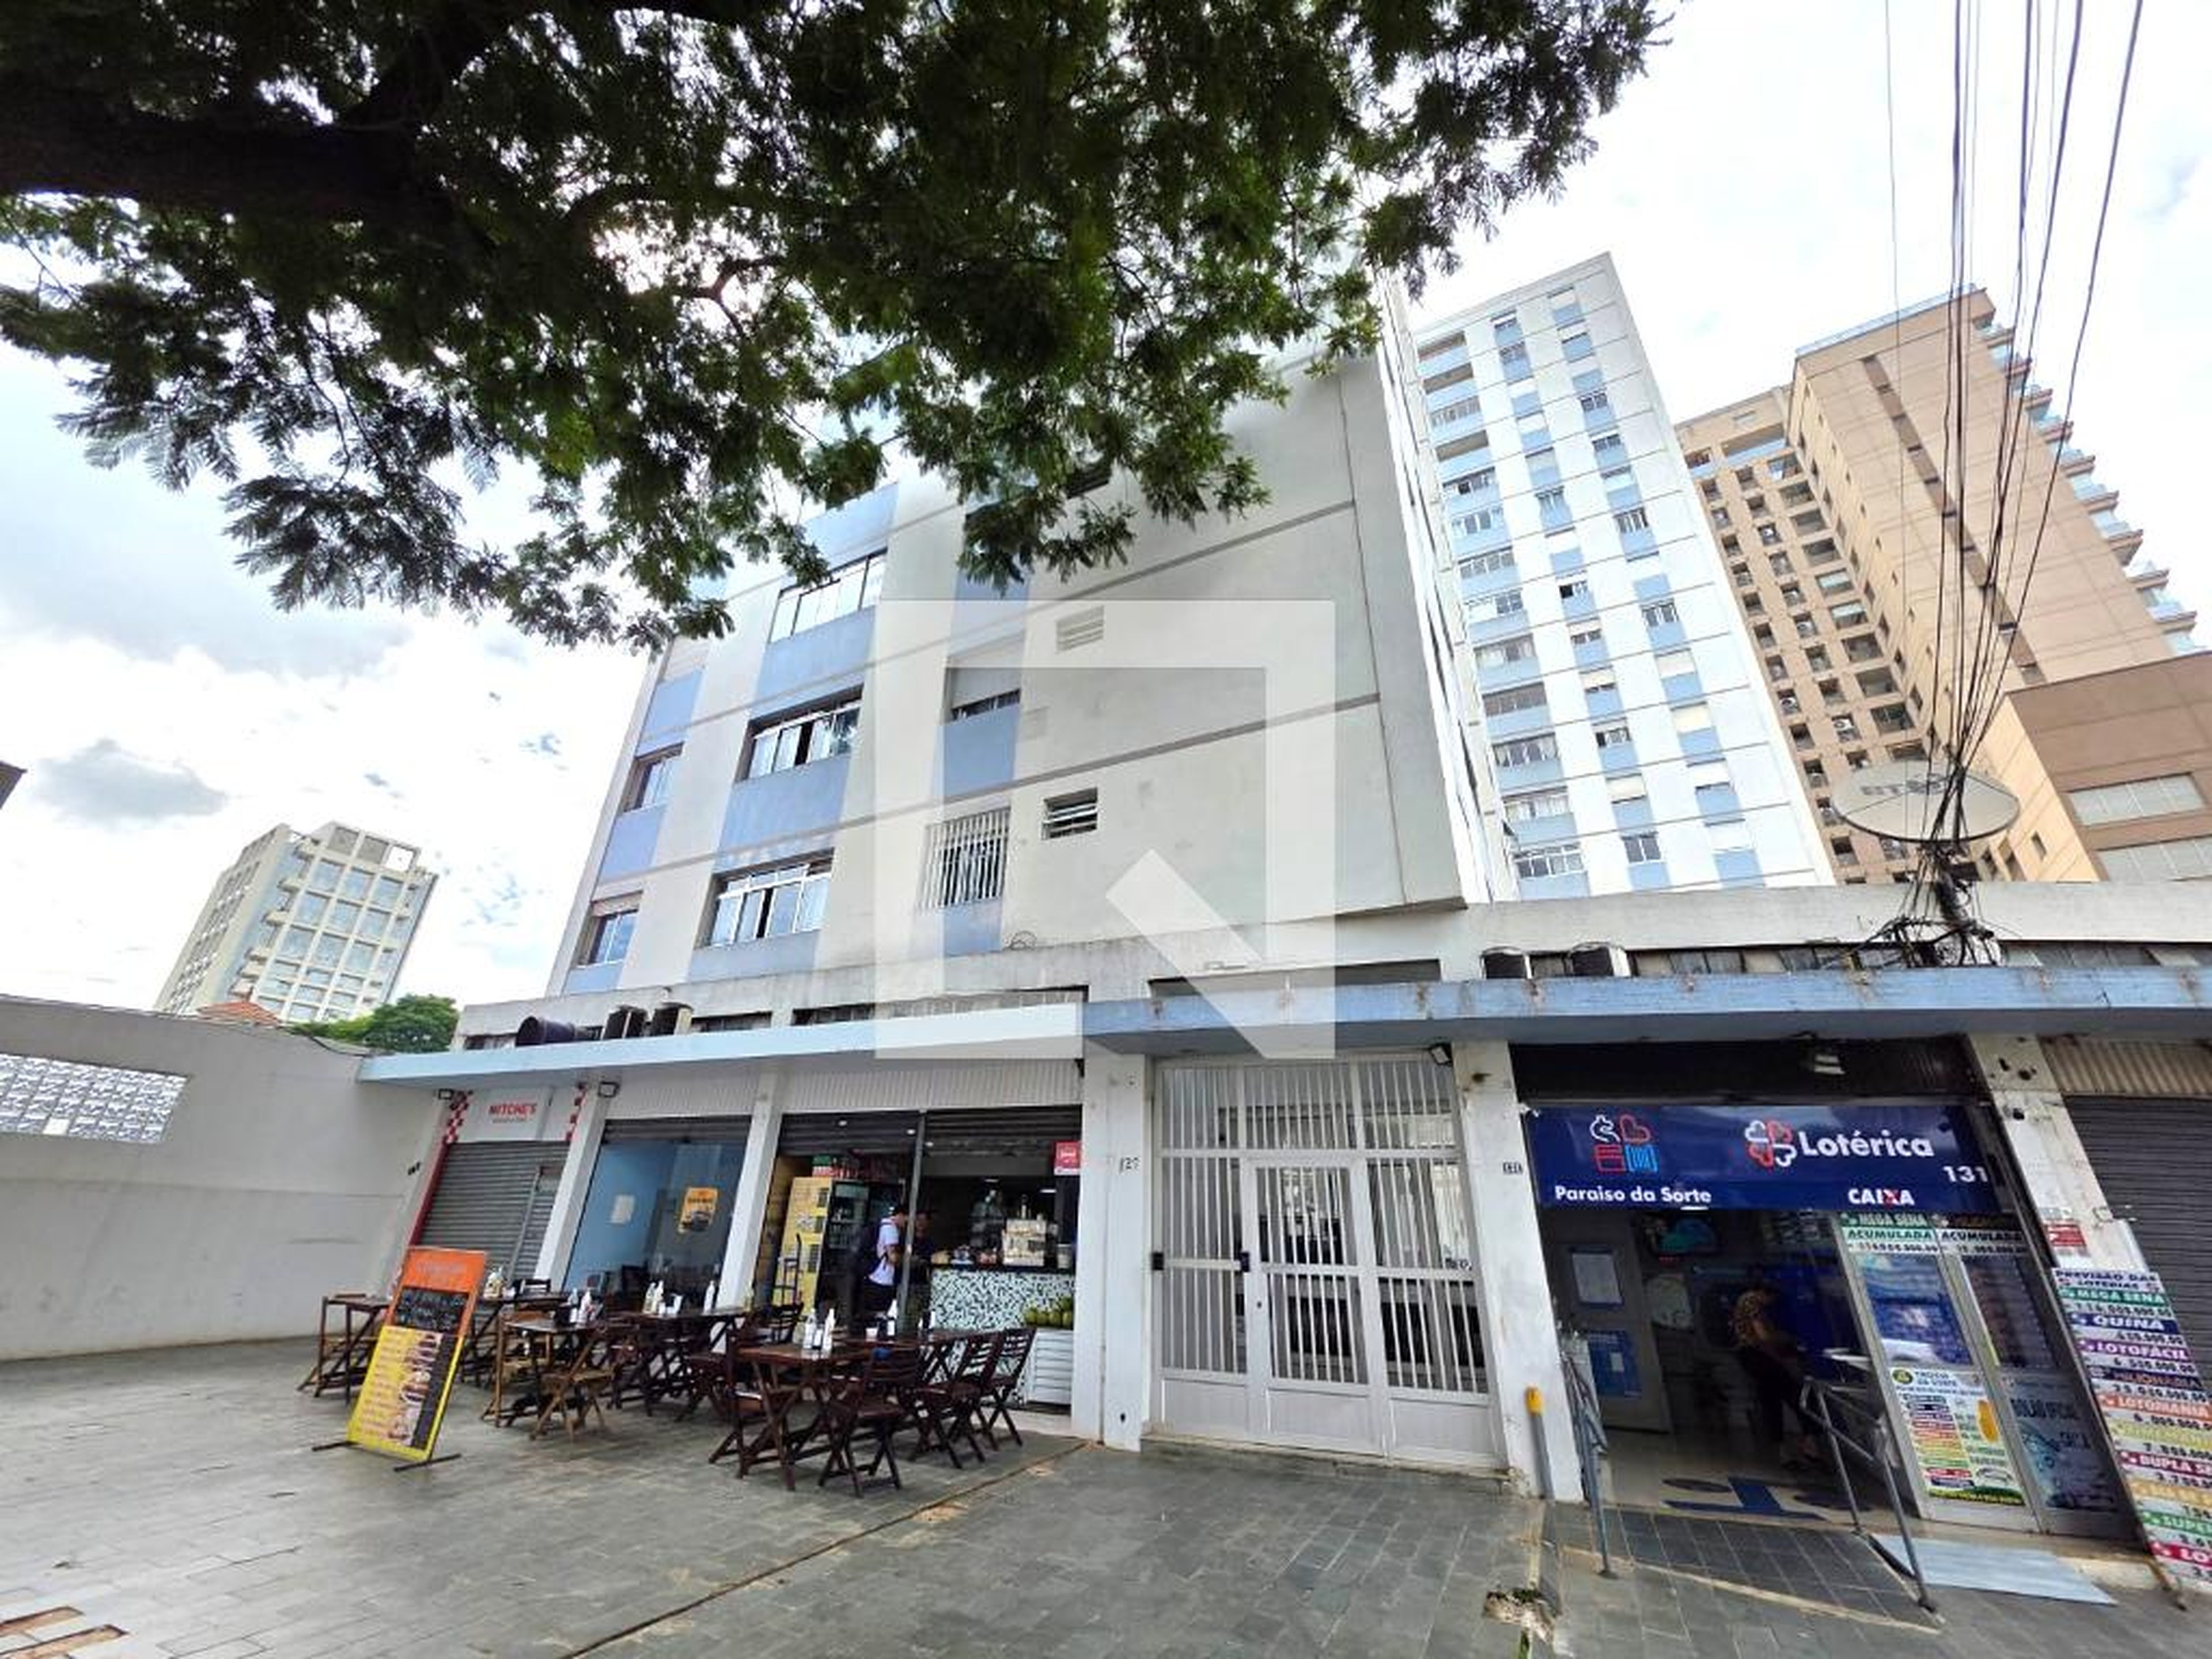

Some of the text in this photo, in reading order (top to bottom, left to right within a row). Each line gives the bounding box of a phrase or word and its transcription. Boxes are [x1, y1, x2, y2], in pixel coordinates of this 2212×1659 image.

[1798, 1129, 1934, 1157] Lotérica
[1943, 1165, 1988, 1183] 131
[1555, 1185, 1713, 1203] Paraiso da Sorte
[1847, 1188, 1915, 1206] CAIXA
[1848, 1229, 1932, 1239] ACUMULADA
[2077, 1289, 2165, 1305] MEGA SENA
[2093, 1316, 2165, 1331] QUINA
[2118, 1397, 2210, 1418] LOTOMANIA
[2140, 1455, 2192, 1472] DUPLA
